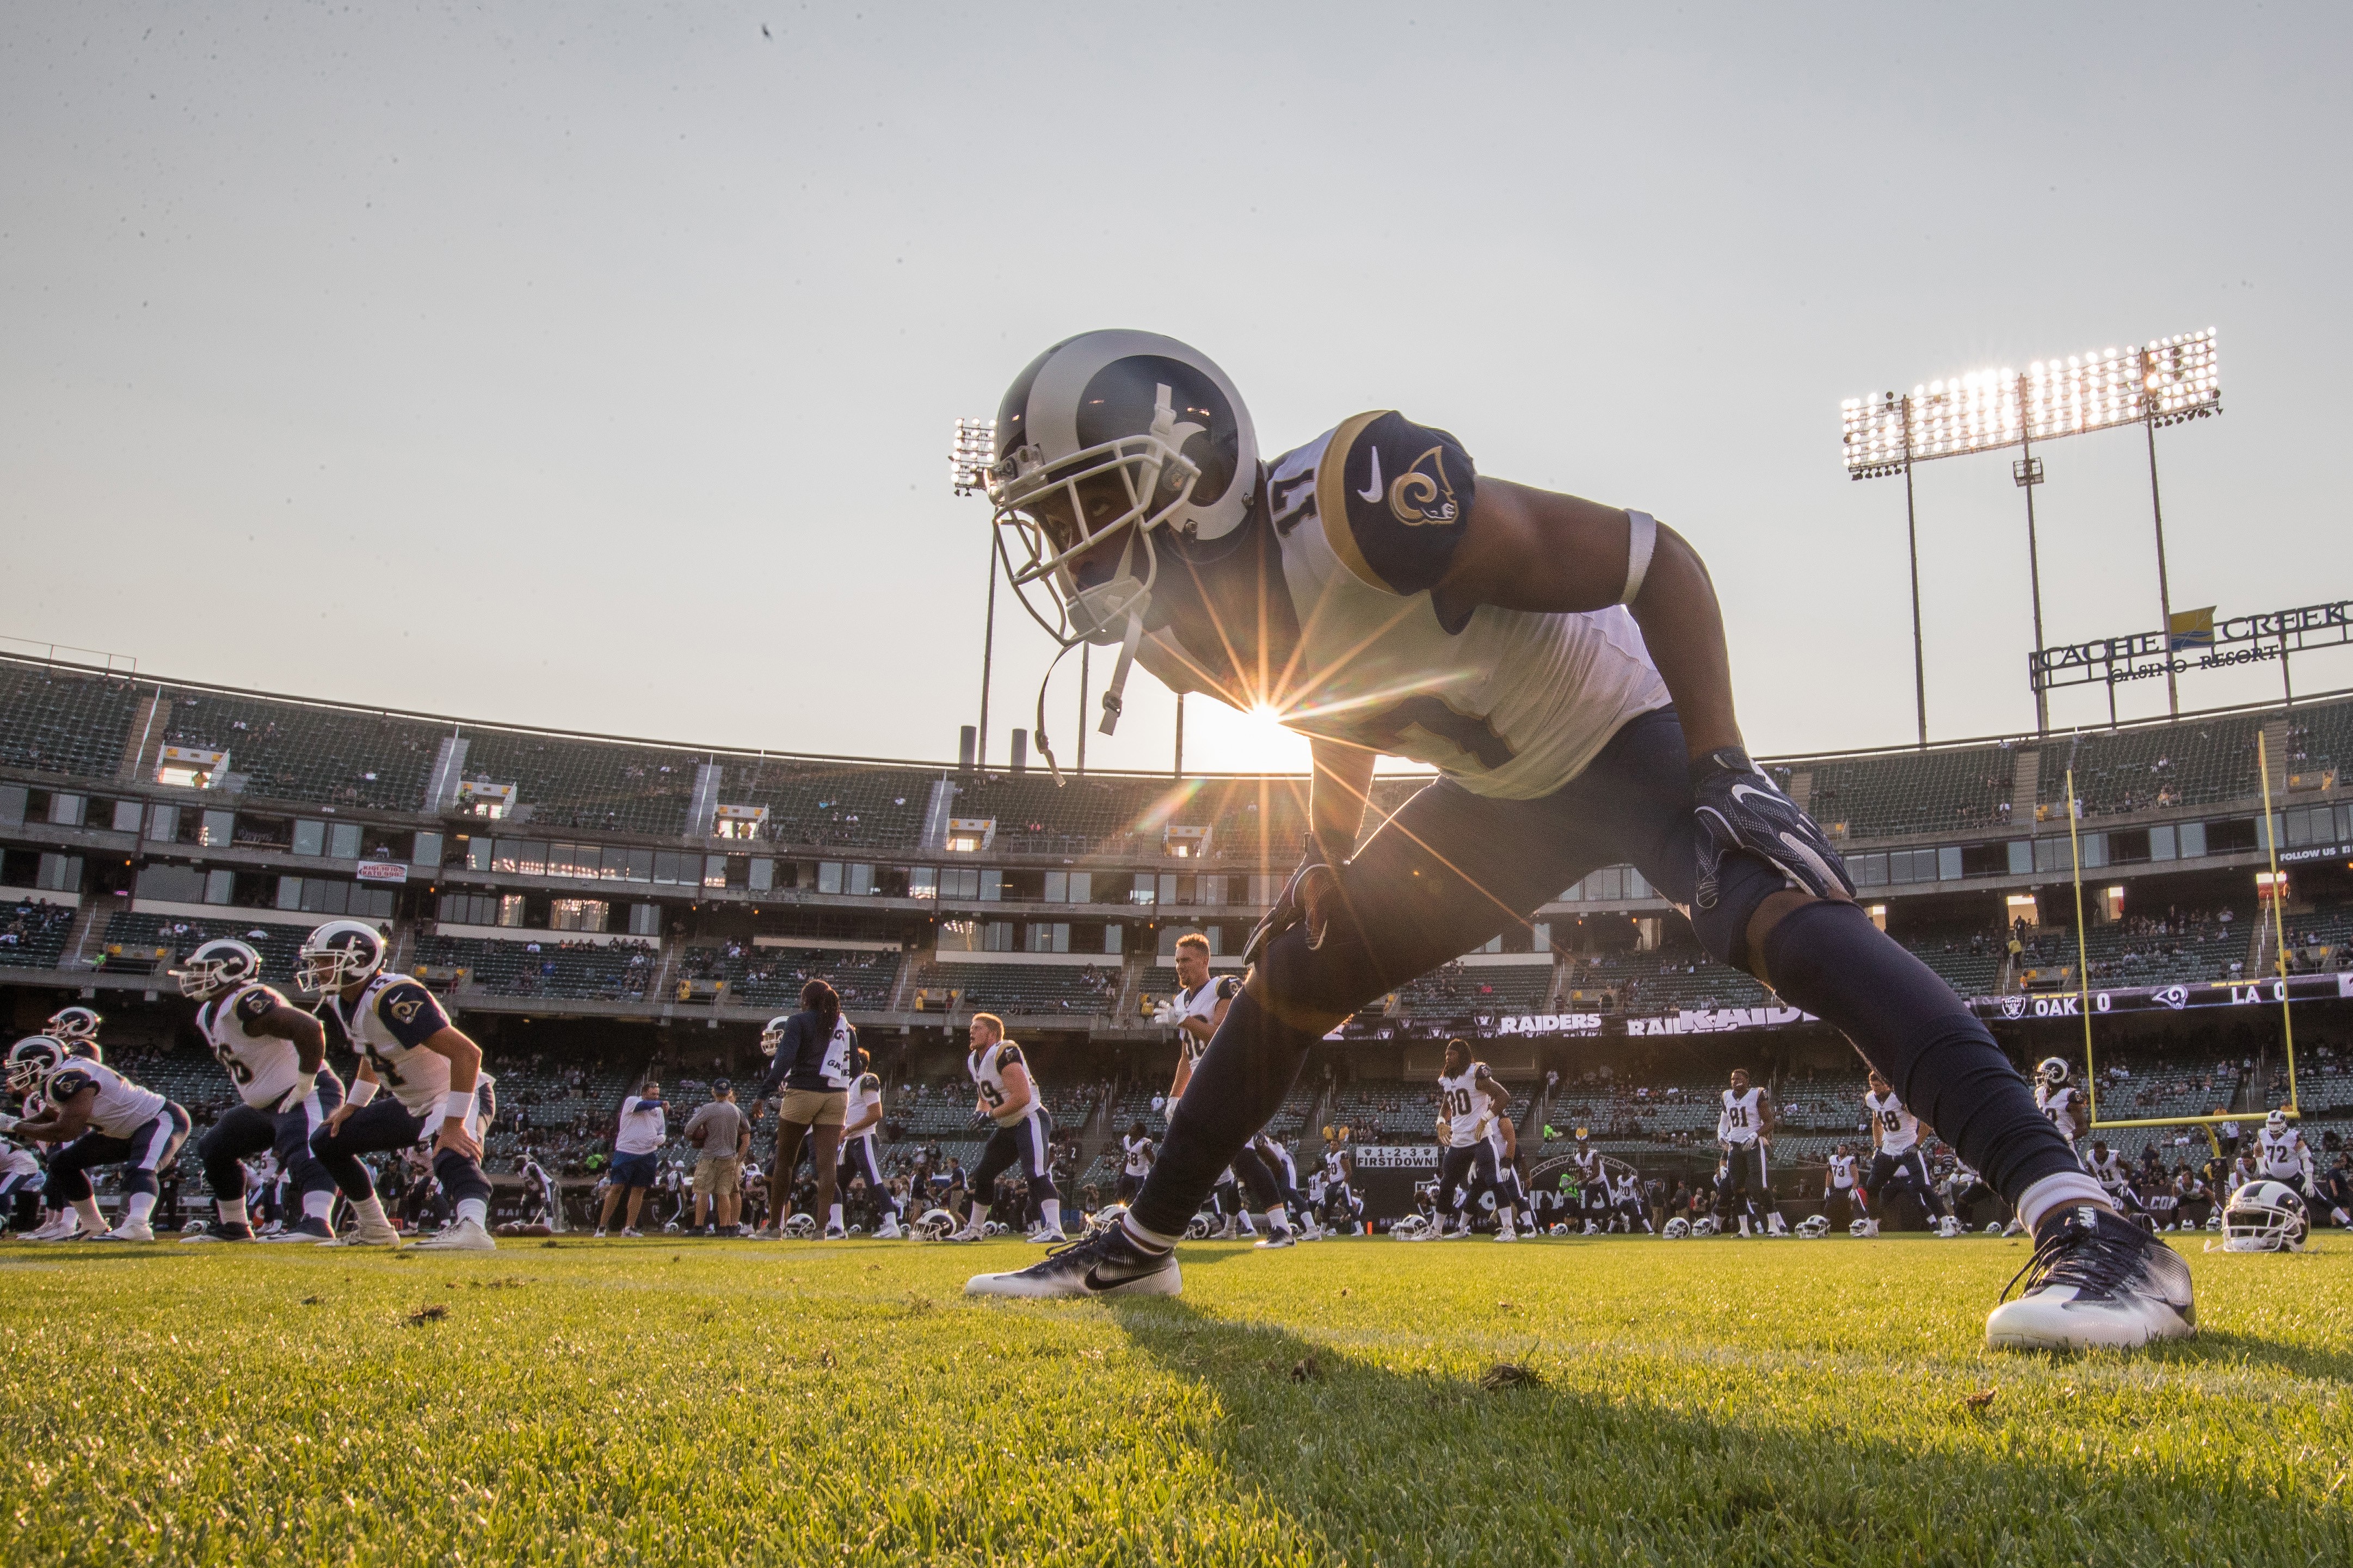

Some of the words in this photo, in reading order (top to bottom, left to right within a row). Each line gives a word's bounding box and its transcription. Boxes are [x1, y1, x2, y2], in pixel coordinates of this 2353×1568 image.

[1270, 467, 1317, 539] 17
[2040, 631, 2160, 669] CACHE
[2222, 601, 2349, 643] CREEK
[2110, 659, 2187, 682] CASINO
[2200, 644, 2280, 670] RESORT
[2280, 849, 2320, 862] FOLLOW
[2322, 847, 2336, 856] US
[2232, 985, 2261, 1004] LA
[2274, 981, 2285, 1002] 0
[2036, 997, 2078, 1017] OAK
[2097, 992, 2111, 1012] 0
[1500, 1013, 1601, 1034] RAIDERS
[1729, 1106, 1750, 1127] 81
[2266, 1145, 2288, 1163] 72
